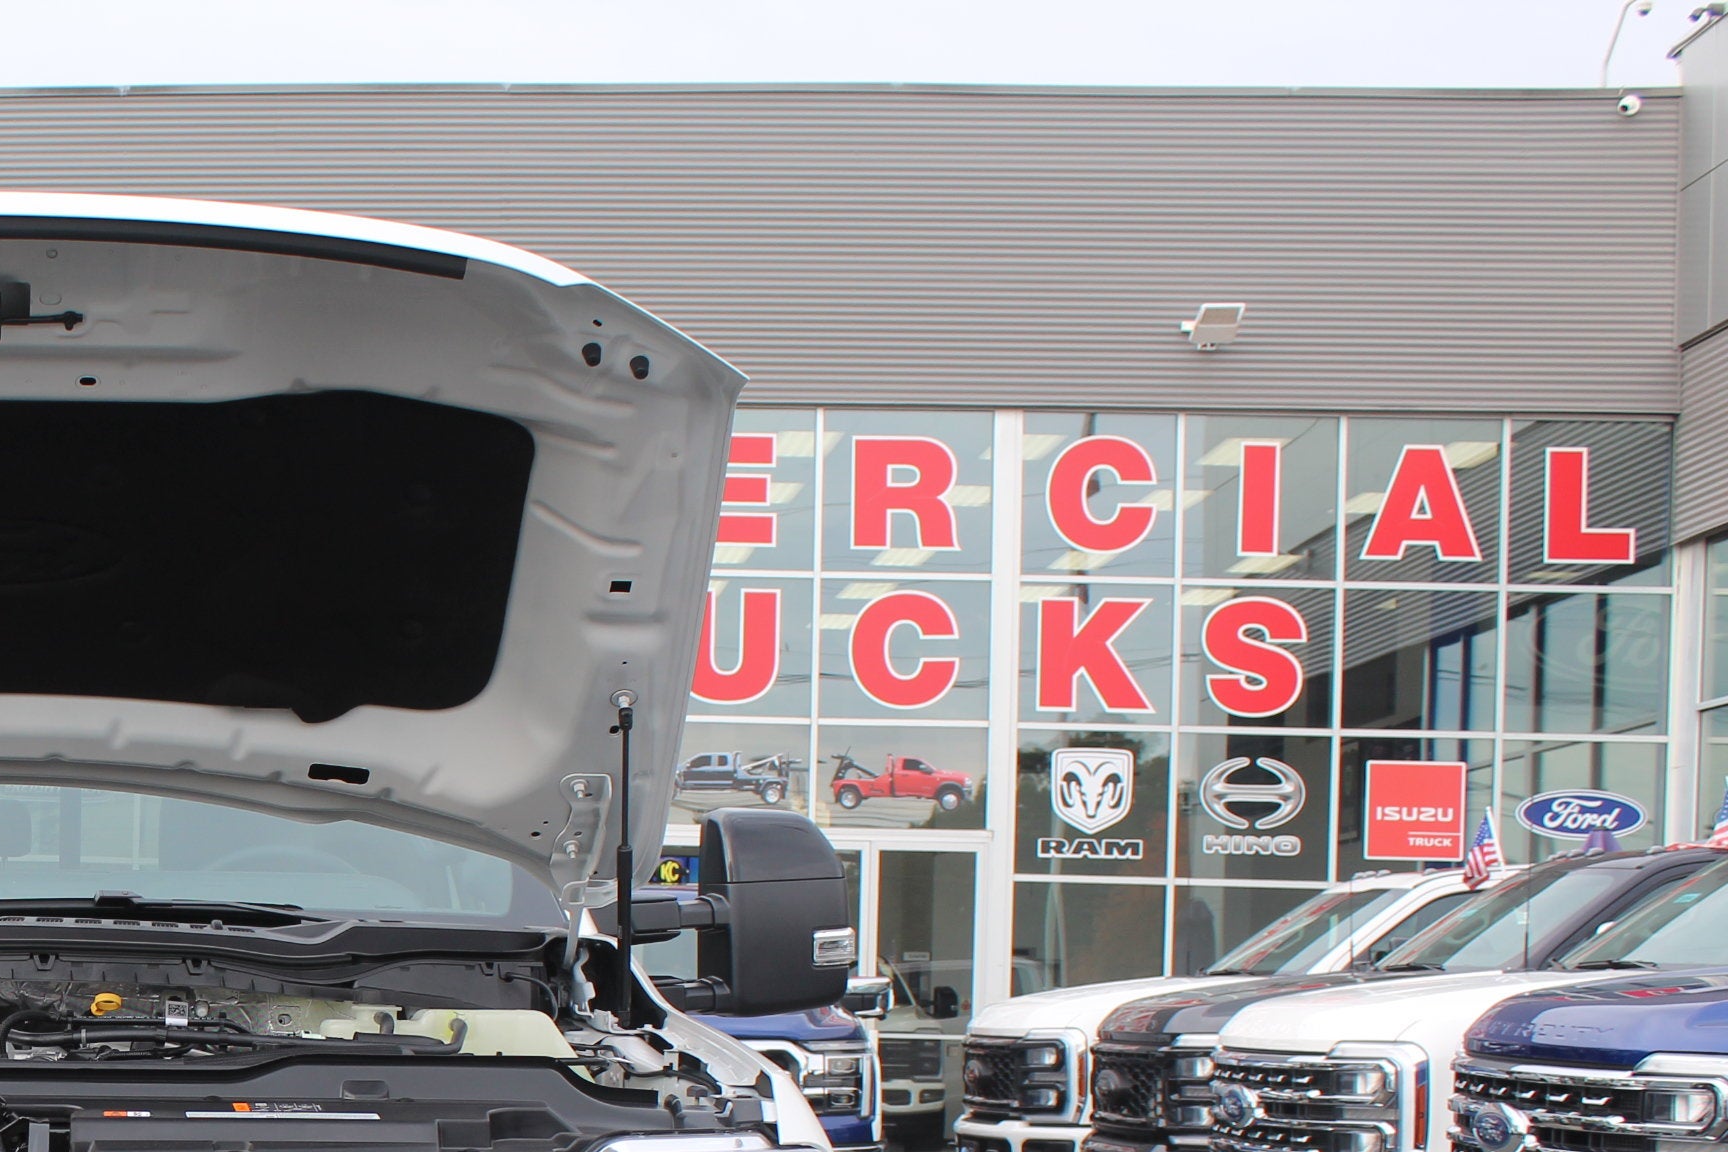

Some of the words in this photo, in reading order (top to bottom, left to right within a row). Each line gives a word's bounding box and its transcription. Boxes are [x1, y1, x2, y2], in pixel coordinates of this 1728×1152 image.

[1375, 806, 1454, 822] ISUZU
[1542, 797, 1622, 830] Ford
[1037, 837, 1143, 860] RAM
[1203, 835, 1301, 857] HINO
[1407, 837, 1453, 847] TRUCK
[660, 860, 680, 882] KC
